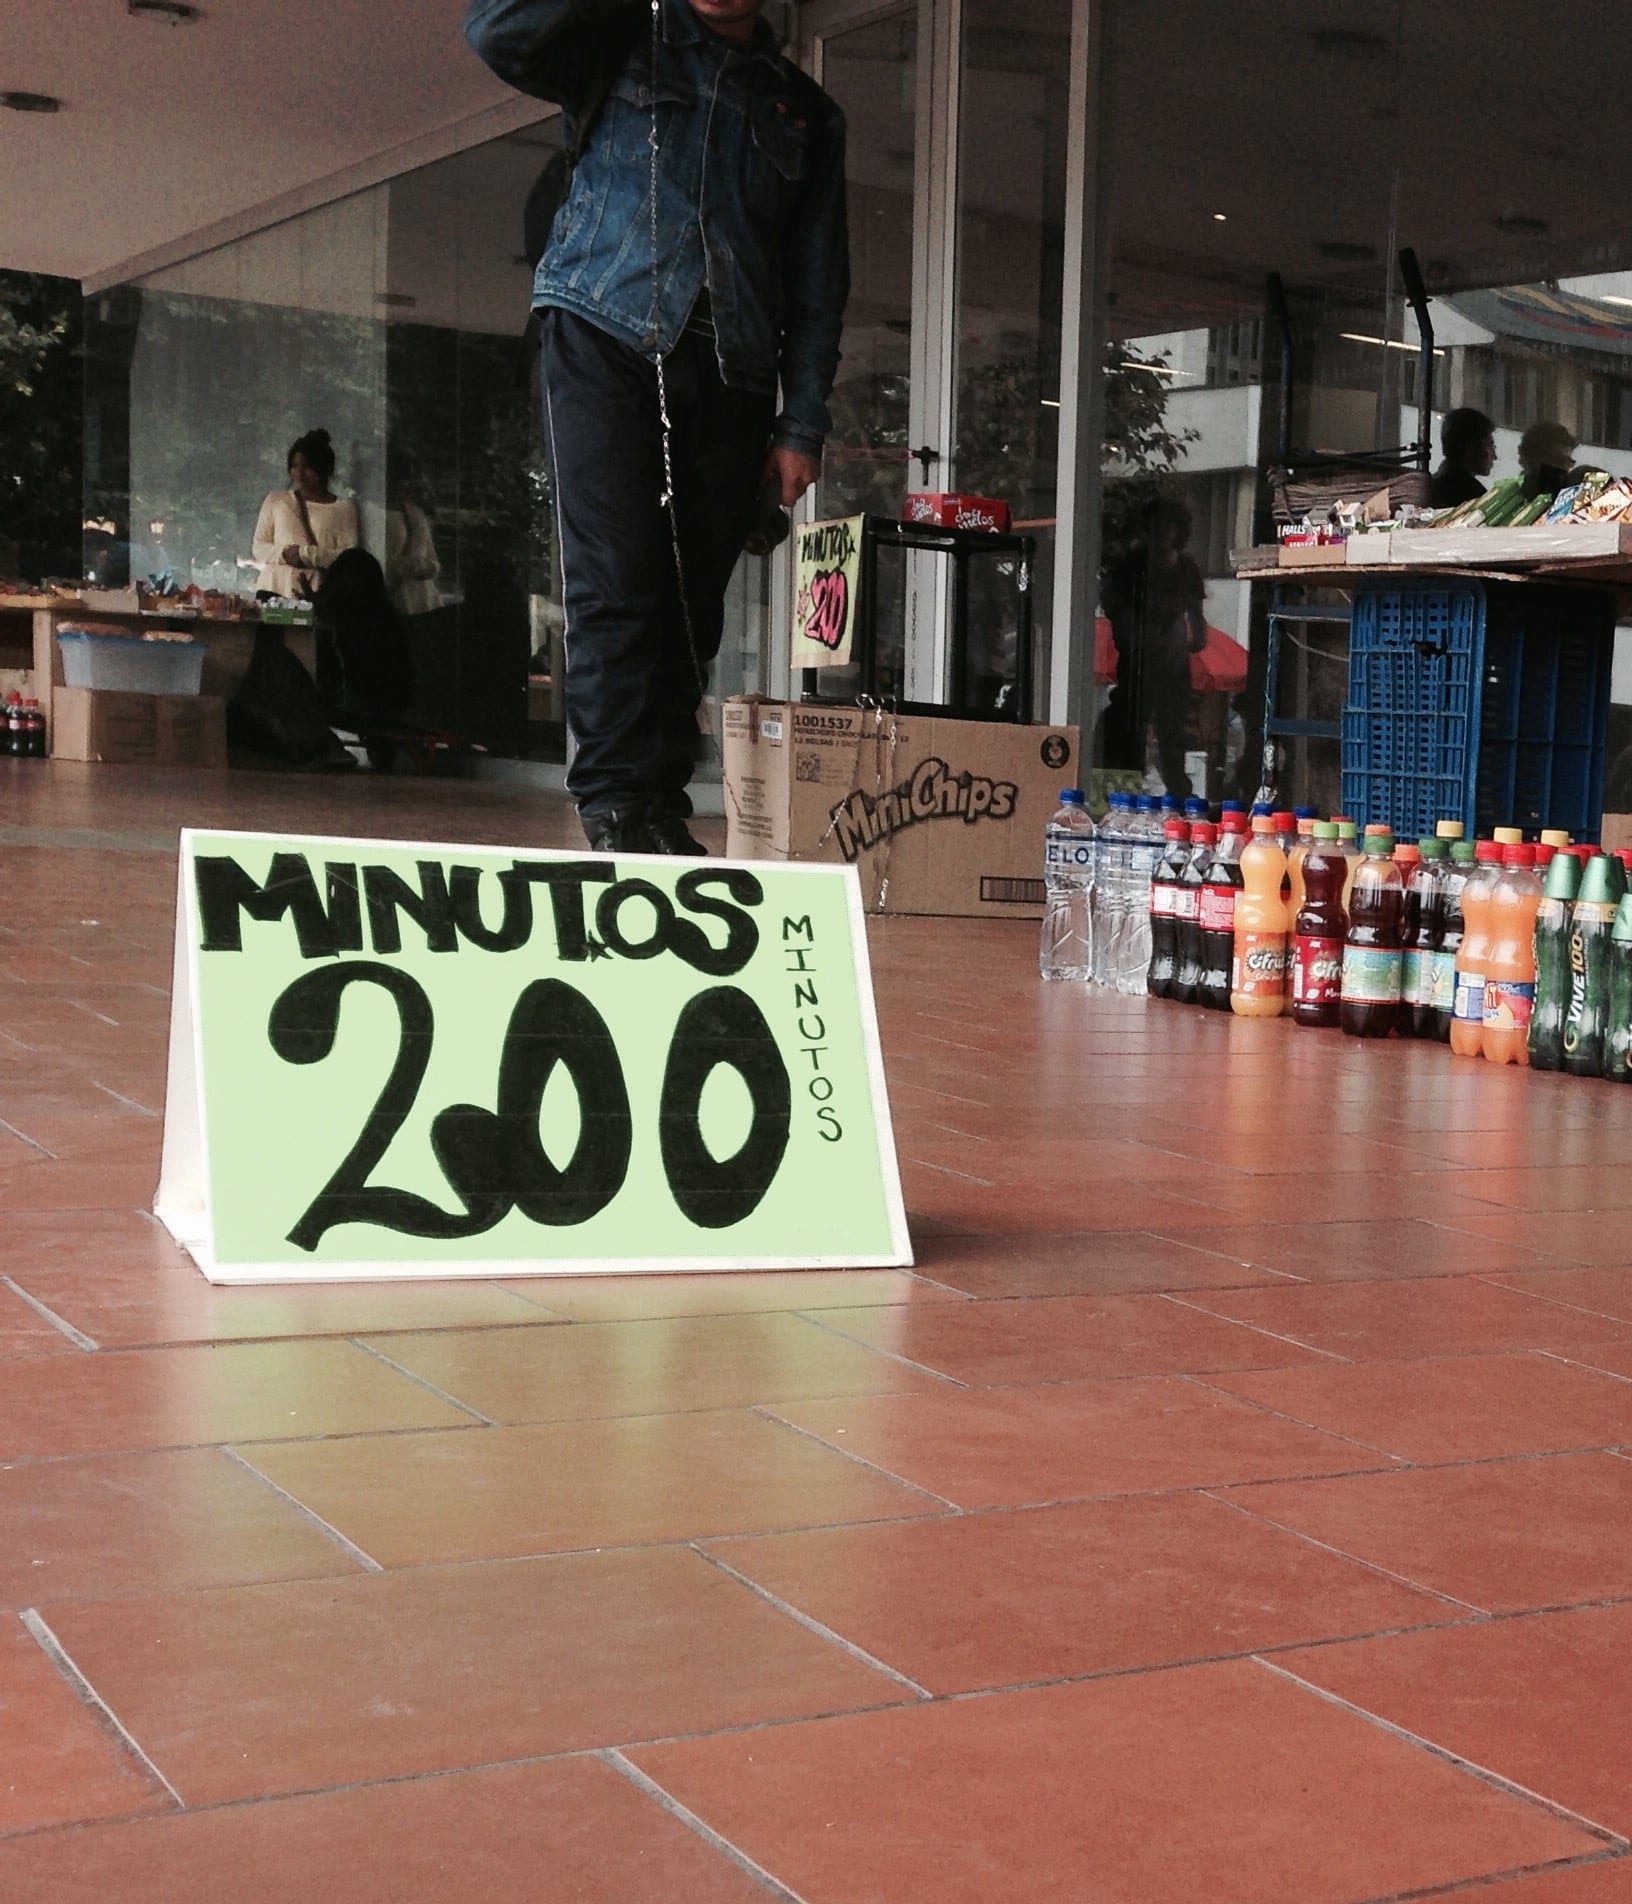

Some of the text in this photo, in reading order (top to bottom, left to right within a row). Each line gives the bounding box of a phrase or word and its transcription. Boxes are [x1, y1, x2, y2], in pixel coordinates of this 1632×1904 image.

[795, 714, 853, 730] 1001537
[194, 851, 765, 977] MINUTOS
[1249, 951, 1284, 970] Cifru
[783, 914, 844, 1144] MINUTOS
[267, 959, 792, 1253] 200
